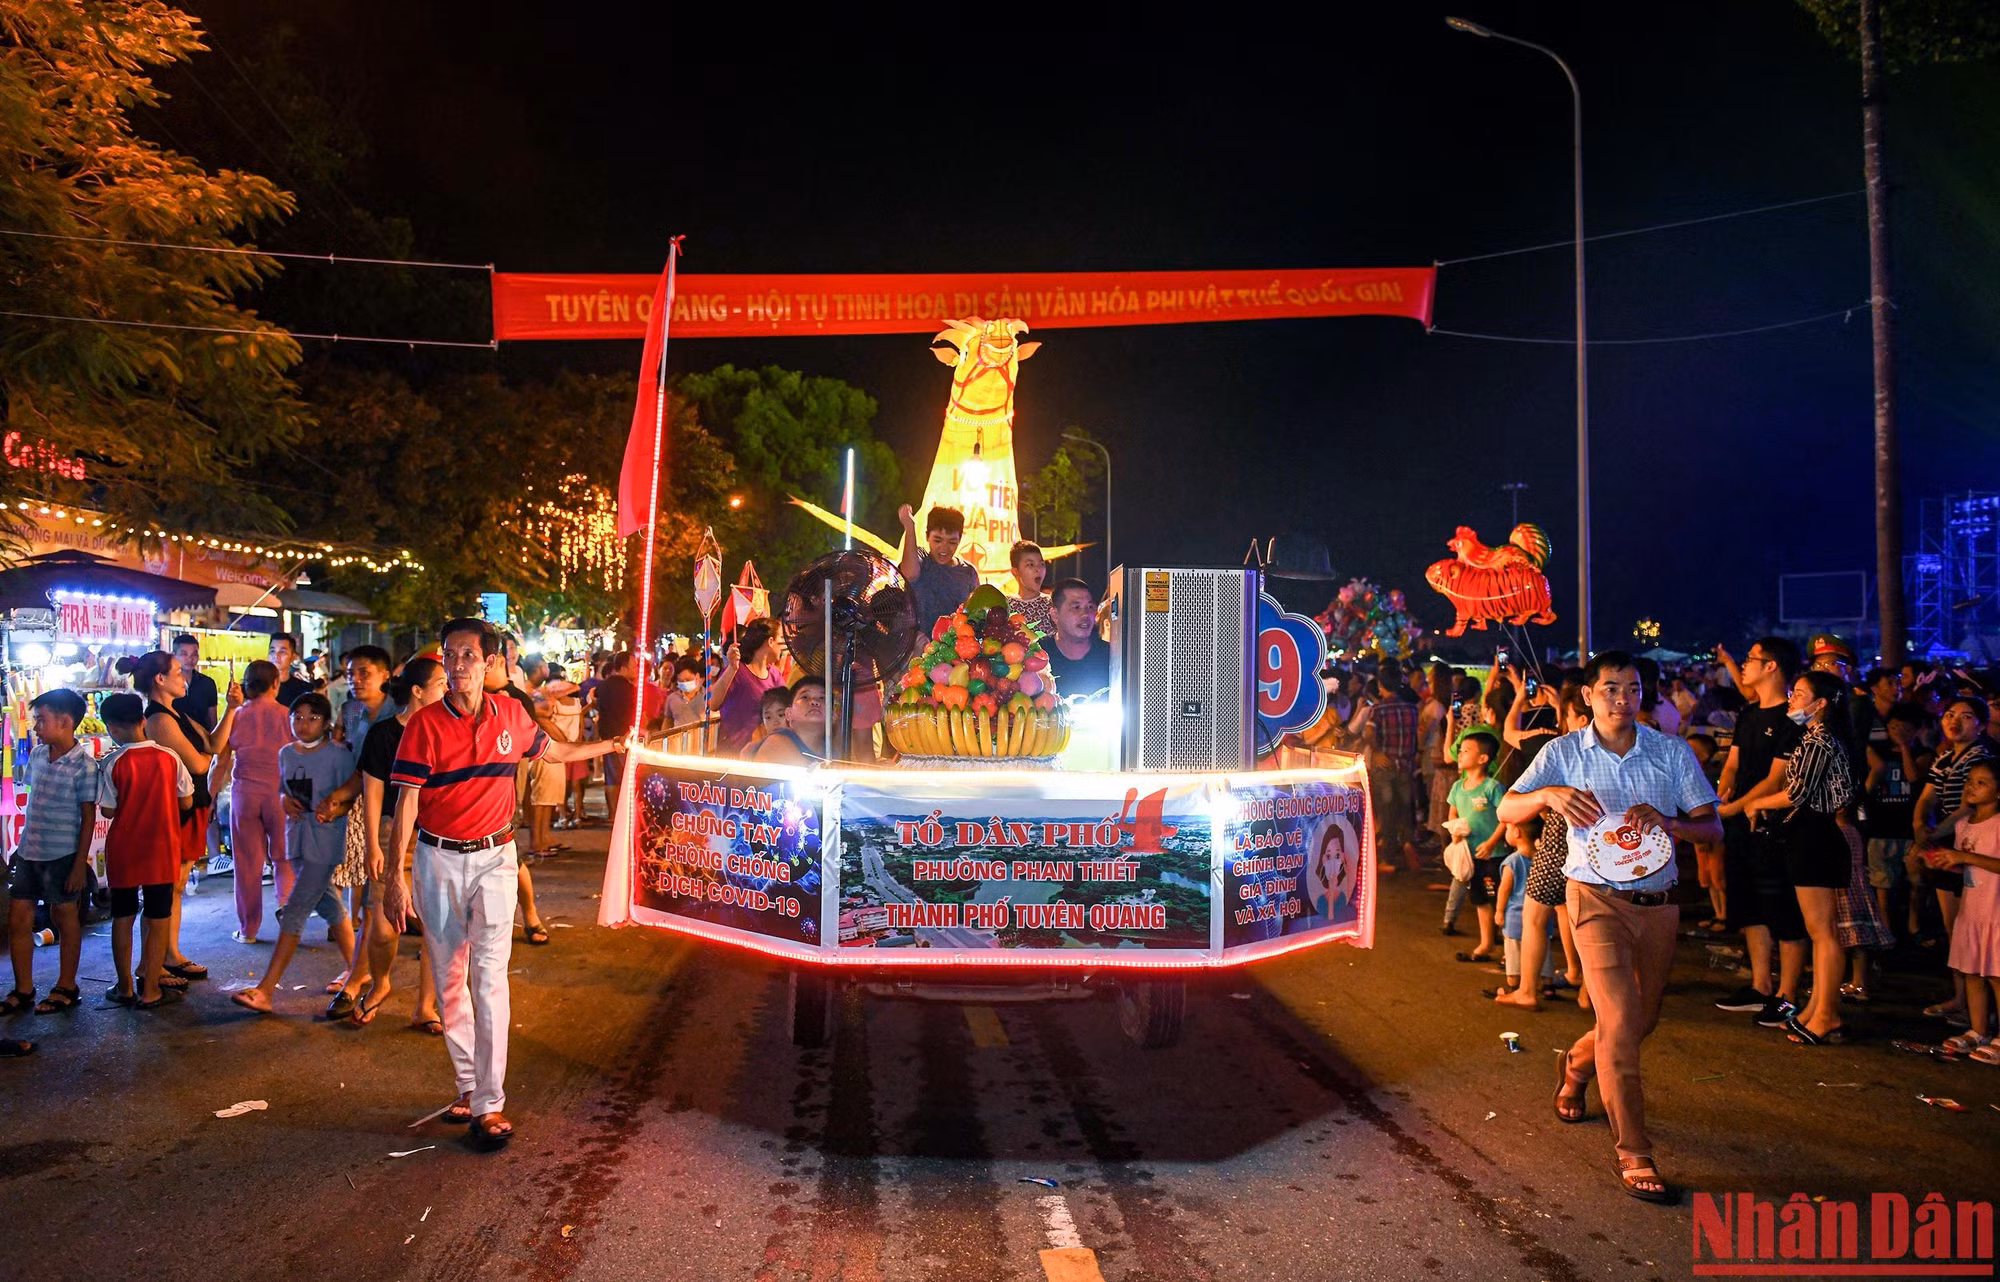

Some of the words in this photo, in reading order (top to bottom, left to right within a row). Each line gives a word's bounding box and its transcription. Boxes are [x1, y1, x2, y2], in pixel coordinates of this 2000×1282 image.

[546, 288, 630, 322] TUYÊN
[636, 294, 728, 322] QANG
[747, 288, 792, 330] HỘI
[796, 293, 828, 329] TỤ
[832, 293, 891, 321] TINH
[896, 293, 949, 320] HOA
[954, 293, 979, 319] DI
[984, 284, 1032, 319] SẢN
[1036, 286, 1086, 317] VĂN
[1091, 285, 1140, 315] HÓA
[1147, 290, 1184, 311] PHI
[1188, 284, 1234, 315] VẬT
[1285, 279, 1352, 307] QUỐC
[60, 599, 91, 637] TRÀ
[678, 780, 726, 806] TOÀN
[731, 785, 772, 811] DÂN
[1314, 793, 1359, 814] COVID-19
[672, 812, 736, 839] CHUNG
[742, 823, 783, 846] TAY
[895, 809, 944, 847] TỔ
[955, 816, 1033, 847] DÂN
[1042, 813, 1121, 847] PHỐ
[1120, 787, 1179, 854] 4
[1235, 832, 1251, 851] LÀ
[1256, 829, 1284, 849] BẢO
[1286, 828, 1303, 850] VỆ
[666, 842, 723, 871] PHÒNG
[727, 851, 790, 882] CHỐNG
[913, 856, 1006, 881] PHƯỜNG
[1013, 861, 1074, 882] PHAN
[1079, 854, 1140, 882] THIẾT
[1233, 856, 1274, 876] CHÍNH
[1277, 854, 1303, 873] BẠN
[659, 872, 703, 898] DỊCH
[708, 883, 800, 918] COVID-19
[1239, 884, 1263, 899] GIA
[1266, 876, 1297, 895] ĐÌNH
[884, 899, 957, 927] THÀNH
[964, 896, 1012, 928] PHỐ
[1014, 900, 1084, 928] TUYÊN
[1089, 904, 1165, 932] QUANG
[1235, 904, 1255, 925] VÀ
[1257, 900, 1277, 920] XÃ
[1280, 898, 1301, 920] HỘI
